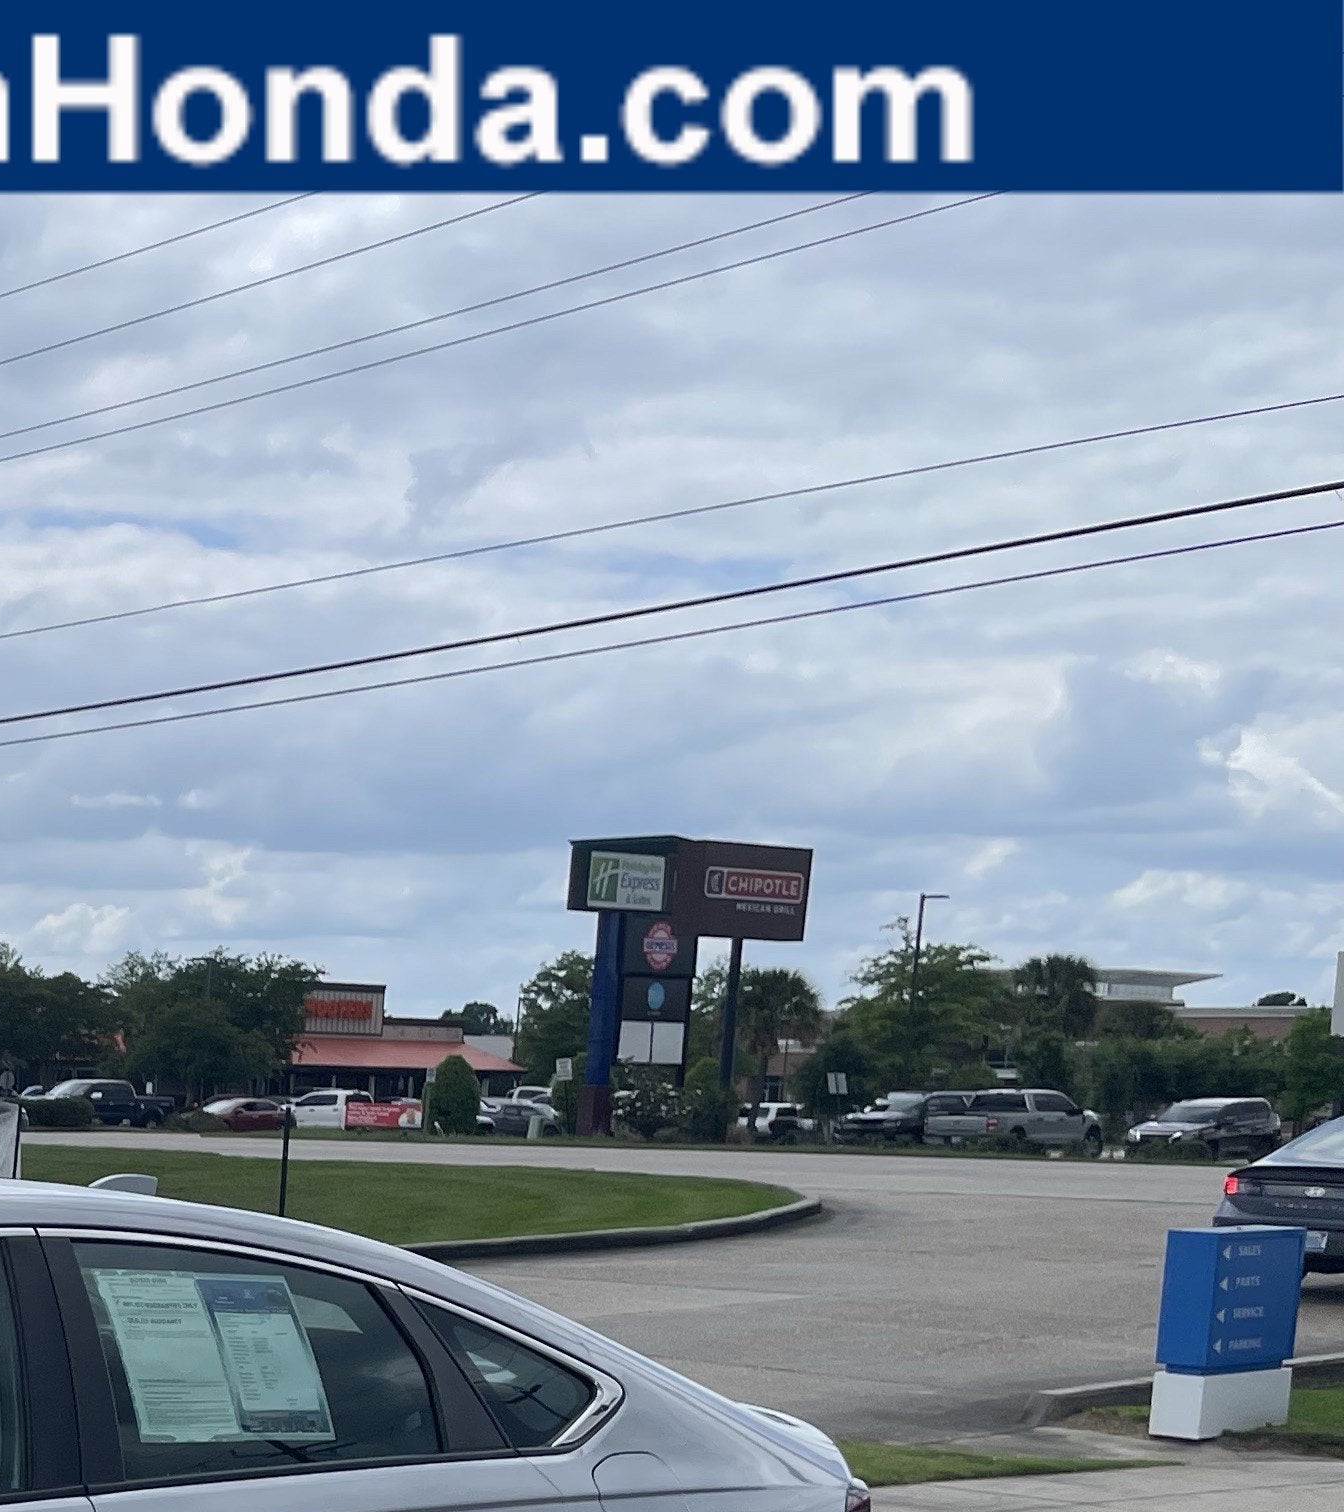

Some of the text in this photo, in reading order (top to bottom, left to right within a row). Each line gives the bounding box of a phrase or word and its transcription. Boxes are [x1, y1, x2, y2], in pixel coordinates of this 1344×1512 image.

[728, 876, 799, 896] CHIPOTLE
[1238, 1245, 1261, 1256] SALES
[1236, 1275, 1261, 1287] PARTS
[1233, 1306, 1263, 1319] SERVICE
